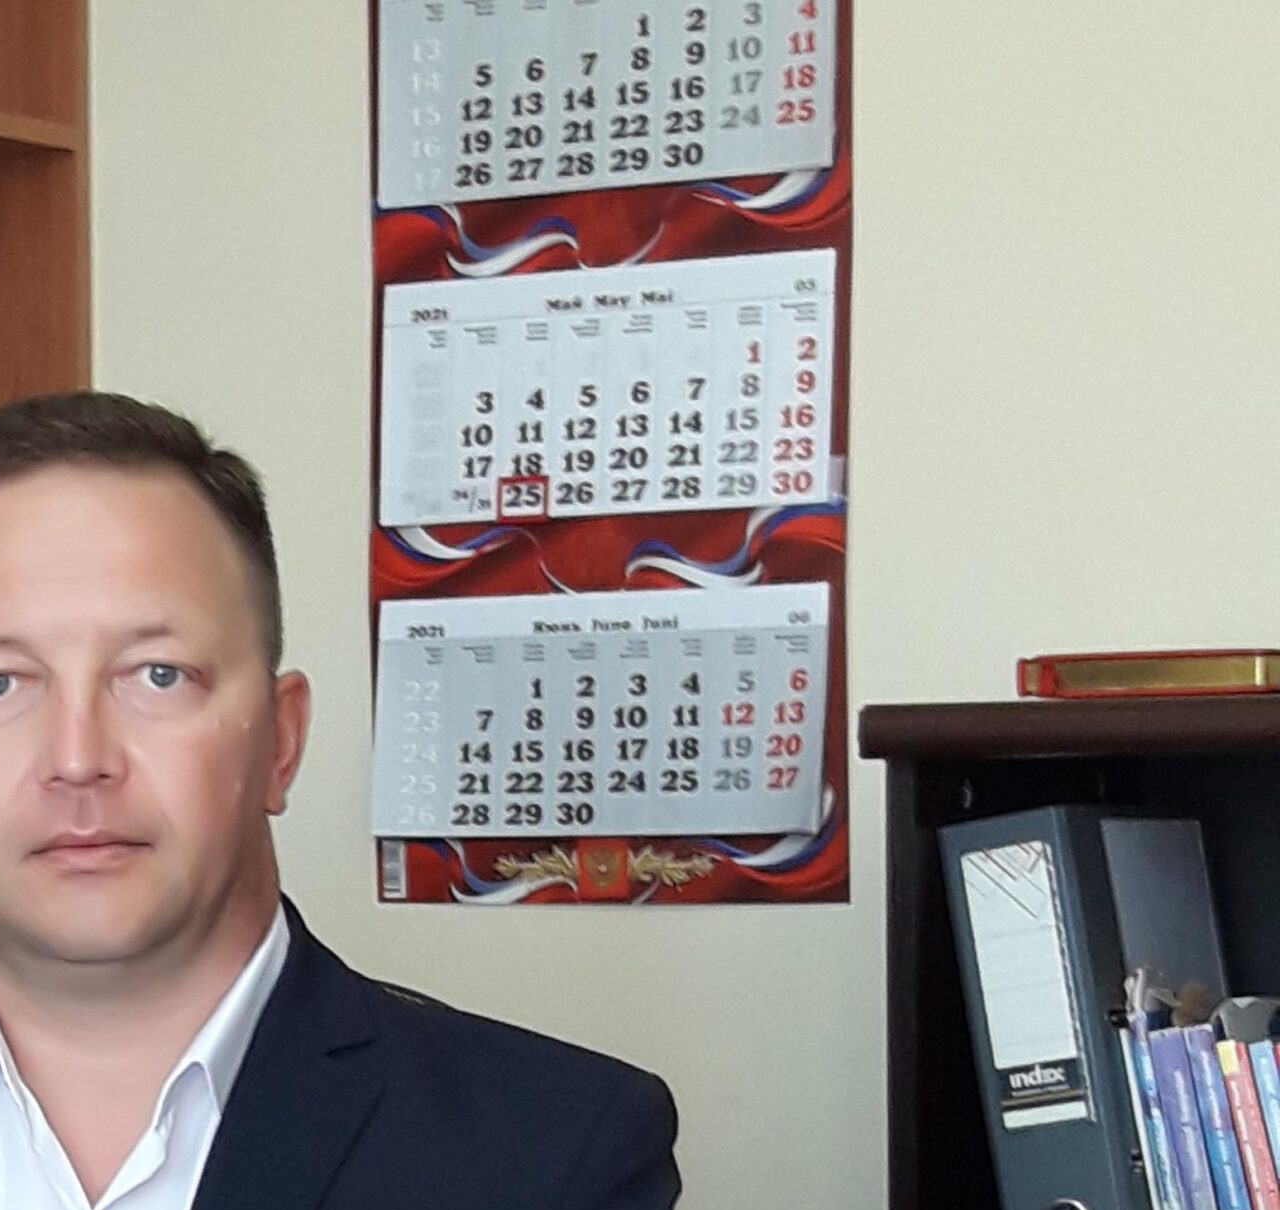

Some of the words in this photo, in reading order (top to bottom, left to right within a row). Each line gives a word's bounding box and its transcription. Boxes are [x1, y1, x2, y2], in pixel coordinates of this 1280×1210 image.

[638, 15, 649, 37] 1
[686, 9, 706, 31] 2
[743, 2, 762, 25] 3
[799, 0, 817, 19] 4
[476, 65, 492, 87] 5
[526, 59, 544, 82] 6
[582, 53, 597, 76] 7
[631, 47, 650, 70] 8
[686, 42, 705, 65] 9
[728, 36, 762, 61] 10
[790, 31, 815, 54] 11
[463, 97, 492, 121] 12
[512, 92, 543, 116] 13
[564, 87, 595, 111] 14
[618, 81, 650, 105] 15
[672, 76, 704, 100] 16
[732, 70, 763, 94] 17
[785, 64, 815, 89] 18
[463, 130, 492, 154] 19
[505, 125, 543, 149] 20
[562, 120, 594, 143] 21
[610, 114, 649, 139] 22
[665, 109, 704, 134] 23
[720, 105, 760, 129] 24
[777, 99, 815, 124] 25
[455, 163, 491, 187] 26
[508, 158, 544, 181] 27
[558, 152, 594, 177] 28
[610, 148, 649, 172] 29
[664, 142, 703, 167] 30
[642, 292, 673, 304] Mai
[749, 341, 760, 363] 1
[798, 337, 816, 360] 2
[476, 392, 493, 413] 3
[527, 389, 544, 409] 4
[580, 385, 596, 407] 5
[631, 381, 649, 403] 6
[688, 378, 706, 400] 7
[741, 374, 760, 397] 8
[797, 370, 815, 393] 9
[462, 424, 493, 447] 10
[519, 421, 543, 443] 11
[565, 418, 596, 440] 12
[617, 414, 648, 437] 13
[670, 411, 702, 434] 14
[727, 408, 759, 430] 15
[781, 405, 815, 428] 16
[464, 456, 493, 478] 17
[512, 454, 542, 475] 18
[564, 450, 595, 472] 19
[609, 447, 648, 470] 20
[668, 444, 700, 467] 21
[718, 440, 758, 464] 22
[774, 437, 813, 461] 23
[505, 485, 541, 506] 25
[556, 482, 593, 504] 26
[612, 479, 648, 502] 27
[662, 476, 701, 499] 28
[717, 474, 757, 497] 29
[773, 471, 813, 494] 30
[643, 616, 678, 631] Juni
[532, 679, 541, 698] 1
[577, 676, 595, 697] 2
[629, 674, 647, 696] 3
[683, 673, 700, 694] 4
[737, 671, 755, 692] 5
[791, 669, 807, 691] 6
[478, 710, 493, 731] 7
[526, 708, 543, 730] 8
[577, 707, 594, 729] 9
[615, 706, 647, 728] 10
[674, 705, 699, 726] 11
[723, 703, 754, 725] 12
[776, 701, 805, 723] 13
[461, 742, 492, 763] 14
[513, 741, 543, 762] 15
[564, 739, 594, 761] 16
[618, 739, 648, 760] 17
[668, 737, 699, 759] 18
[722, 736, 753, 758] 19
[767, 734, 802, 756] 20
[459, 773, 490, 794] 21
[506, 772, 543, 794] 22
[558, 771, 594, 793] 23
[608, 771, 646, 793] 24
[661, 770, 698, 792] 25
[714, 768, 751, 791] 26
[768, 766, 799, 789] 27
[452, 804, 490, 825] 28
[505, 803, 543, 825] 29
[558, 803, 594, 825] 30
[1010, 1064, 1066, 1088] index
